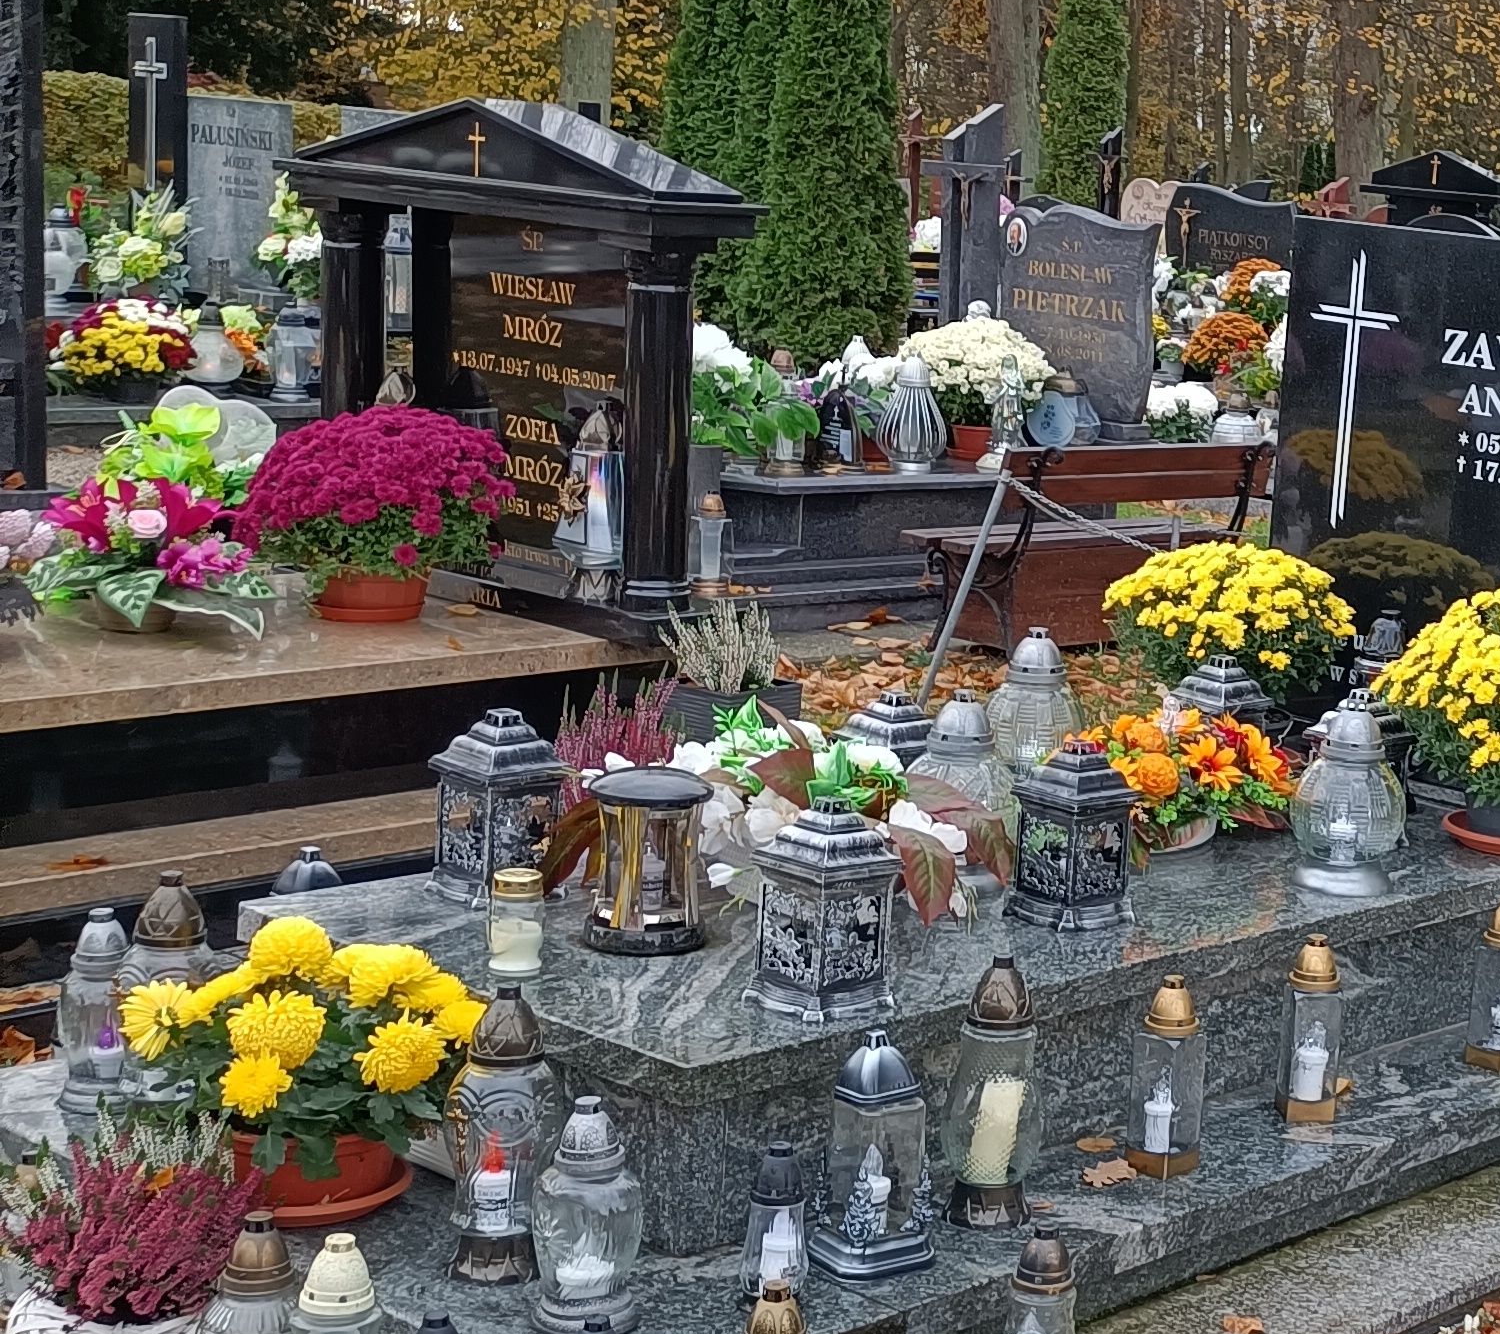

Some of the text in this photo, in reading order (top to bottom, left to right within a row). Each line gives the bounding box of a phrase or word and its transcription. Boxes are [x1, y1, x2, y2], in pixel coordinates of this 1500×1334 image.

[490, 271, 577, 305] WIESŁAW
[1012, 288, 1127, 322] PIETRZAK
[503, 313, 563, 348] MRÓZ
[505, 414, 562, 446] ZOFIA
[503, 454, 564, 489] MRÓZ
